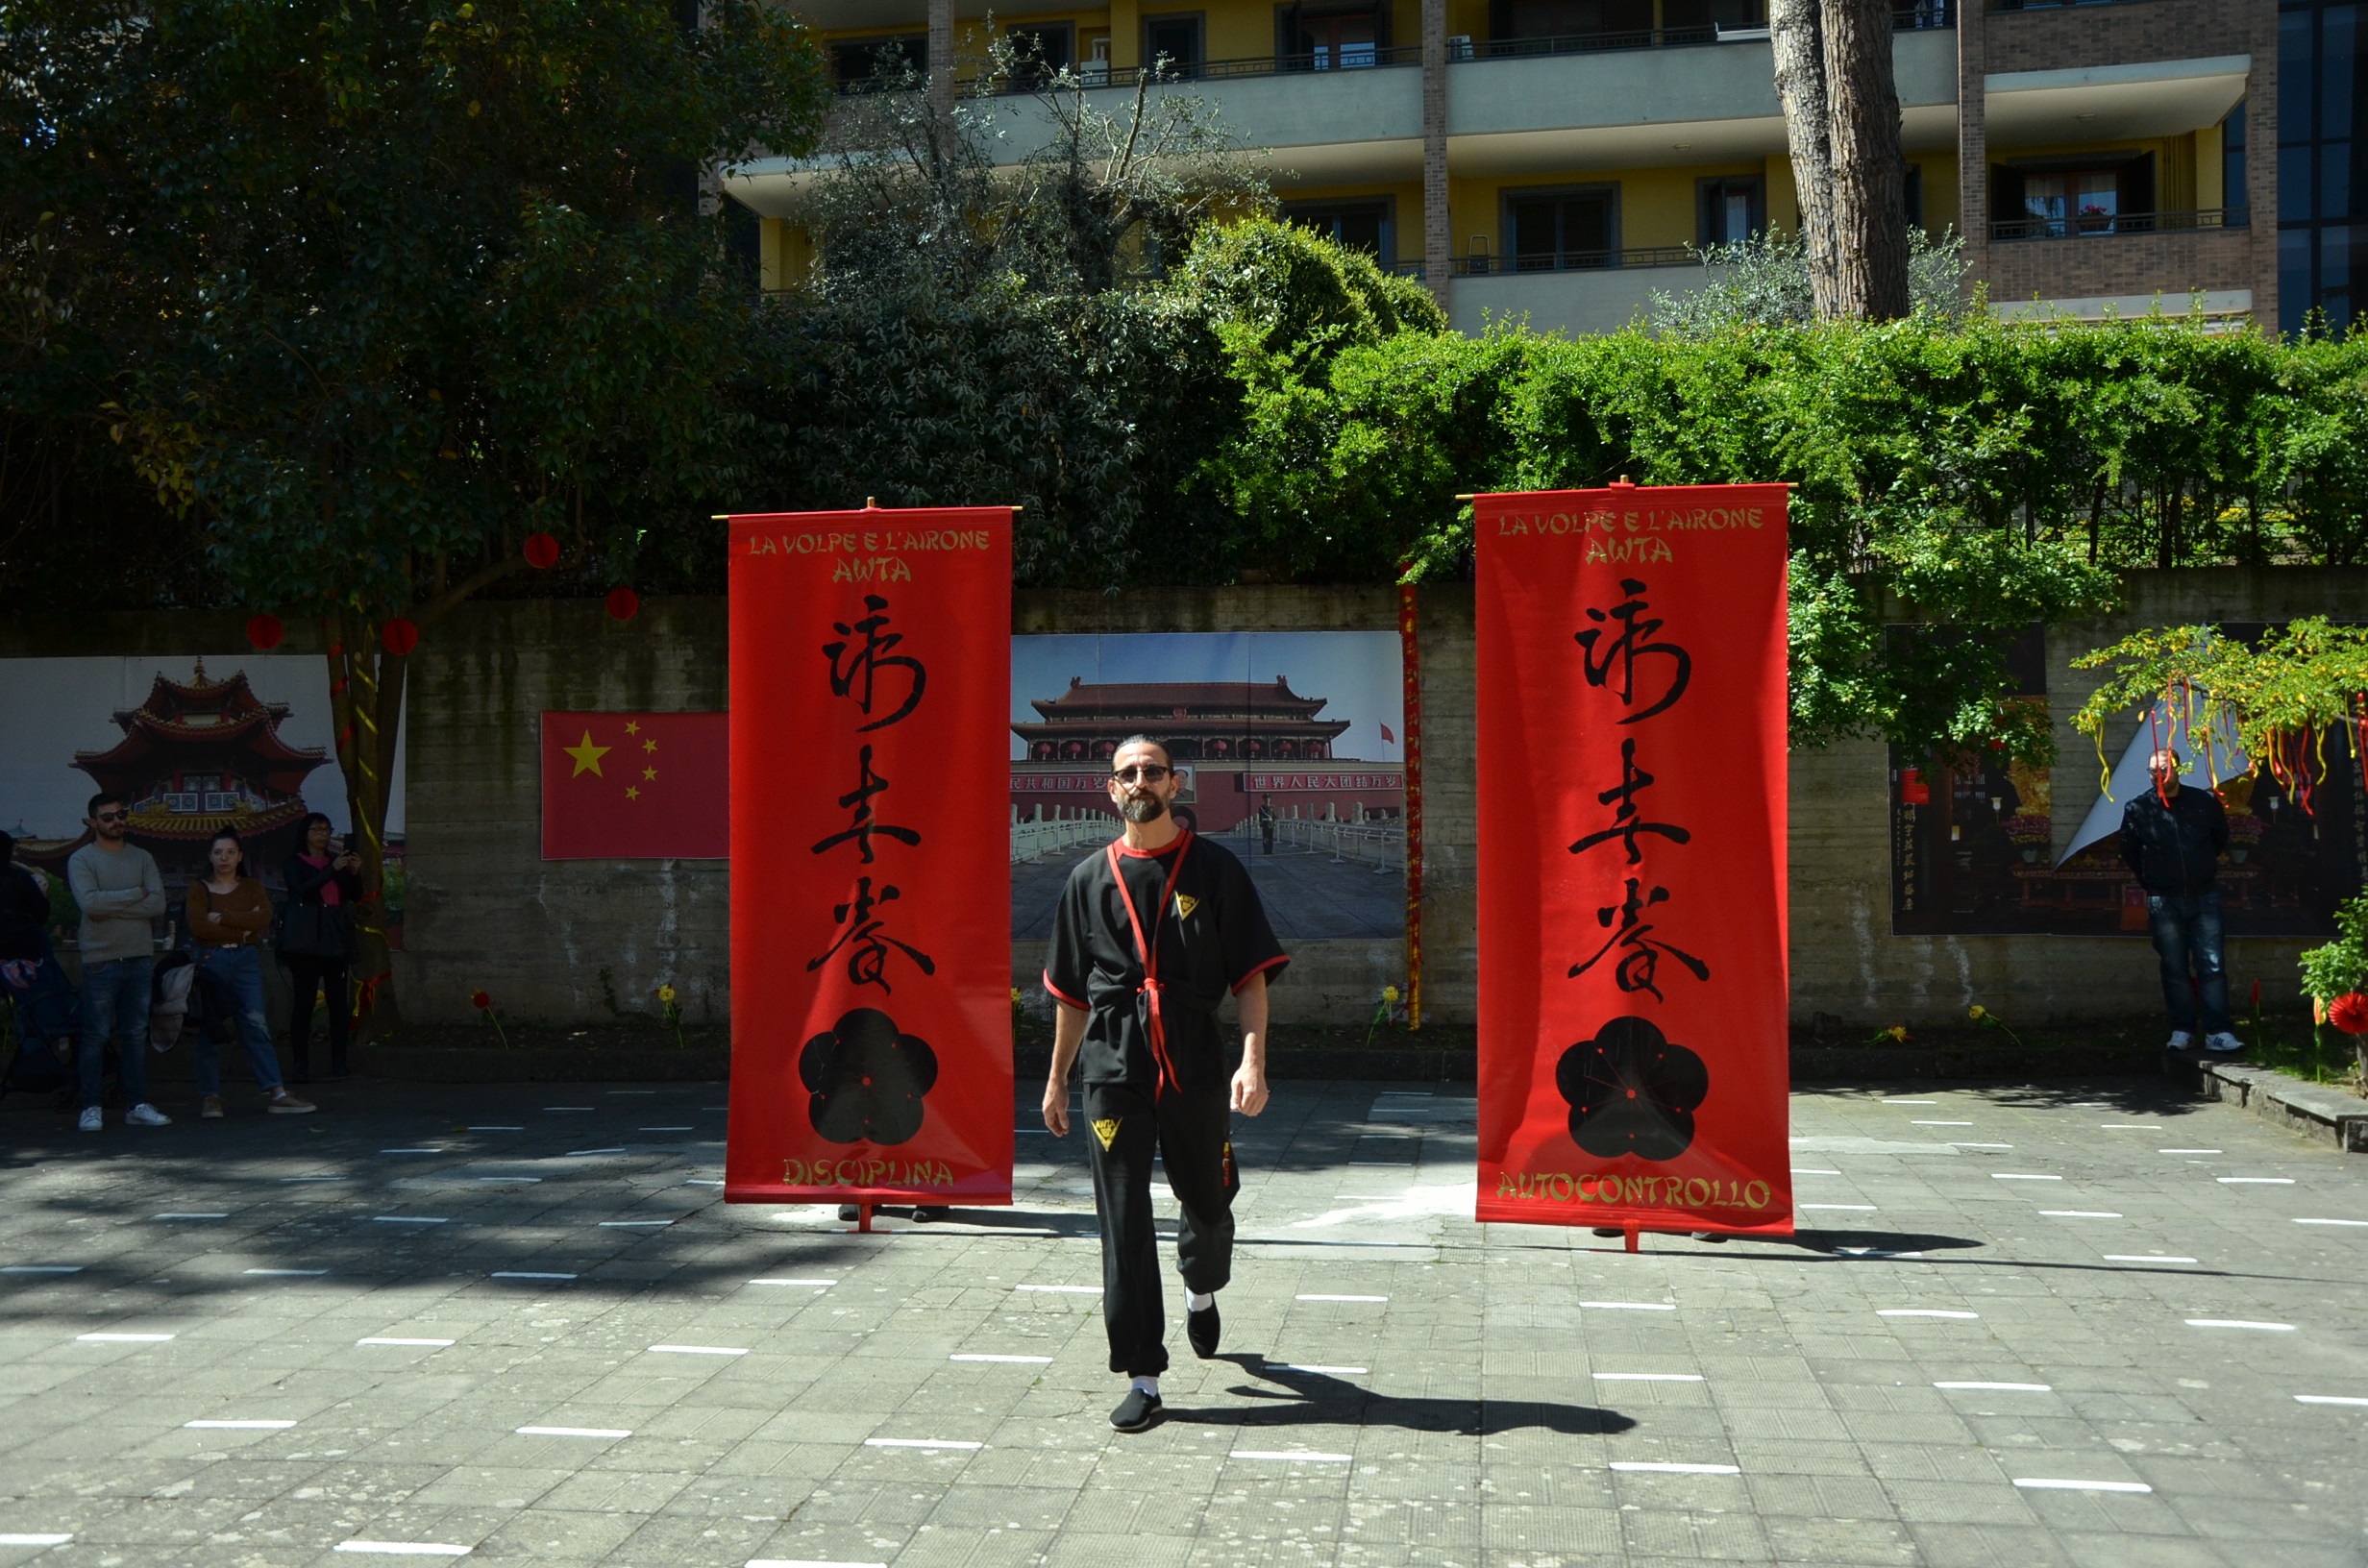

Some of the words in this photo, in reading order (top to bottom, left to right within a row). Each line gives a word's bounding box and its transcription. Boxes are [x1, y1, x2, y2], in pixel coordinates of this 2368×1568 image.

[1498, 516, 1529, 536] LA
[1535, 512, 1616, 535] VOLPE
[1623, 511, 1640, 531] E
[1648, 507, 1765, 531] L'AIRONE
[749, 536, 777, 554] LA
[783, 532, 856, 554] VOLPE
[864, 532, 878, 551] E
[885, 529, 991, 551] L'AIRONE
[1586, 537, 1673, 565] AWTA
[832, 556, 911, 583] AWTA
[1253, 774, 1397, 790] 世界人民大团结万岁
[783, 1159, 953, 1188] DISCIPLINA
[1495, 1171, 1771, 1210] AUTOCONTROLLO
